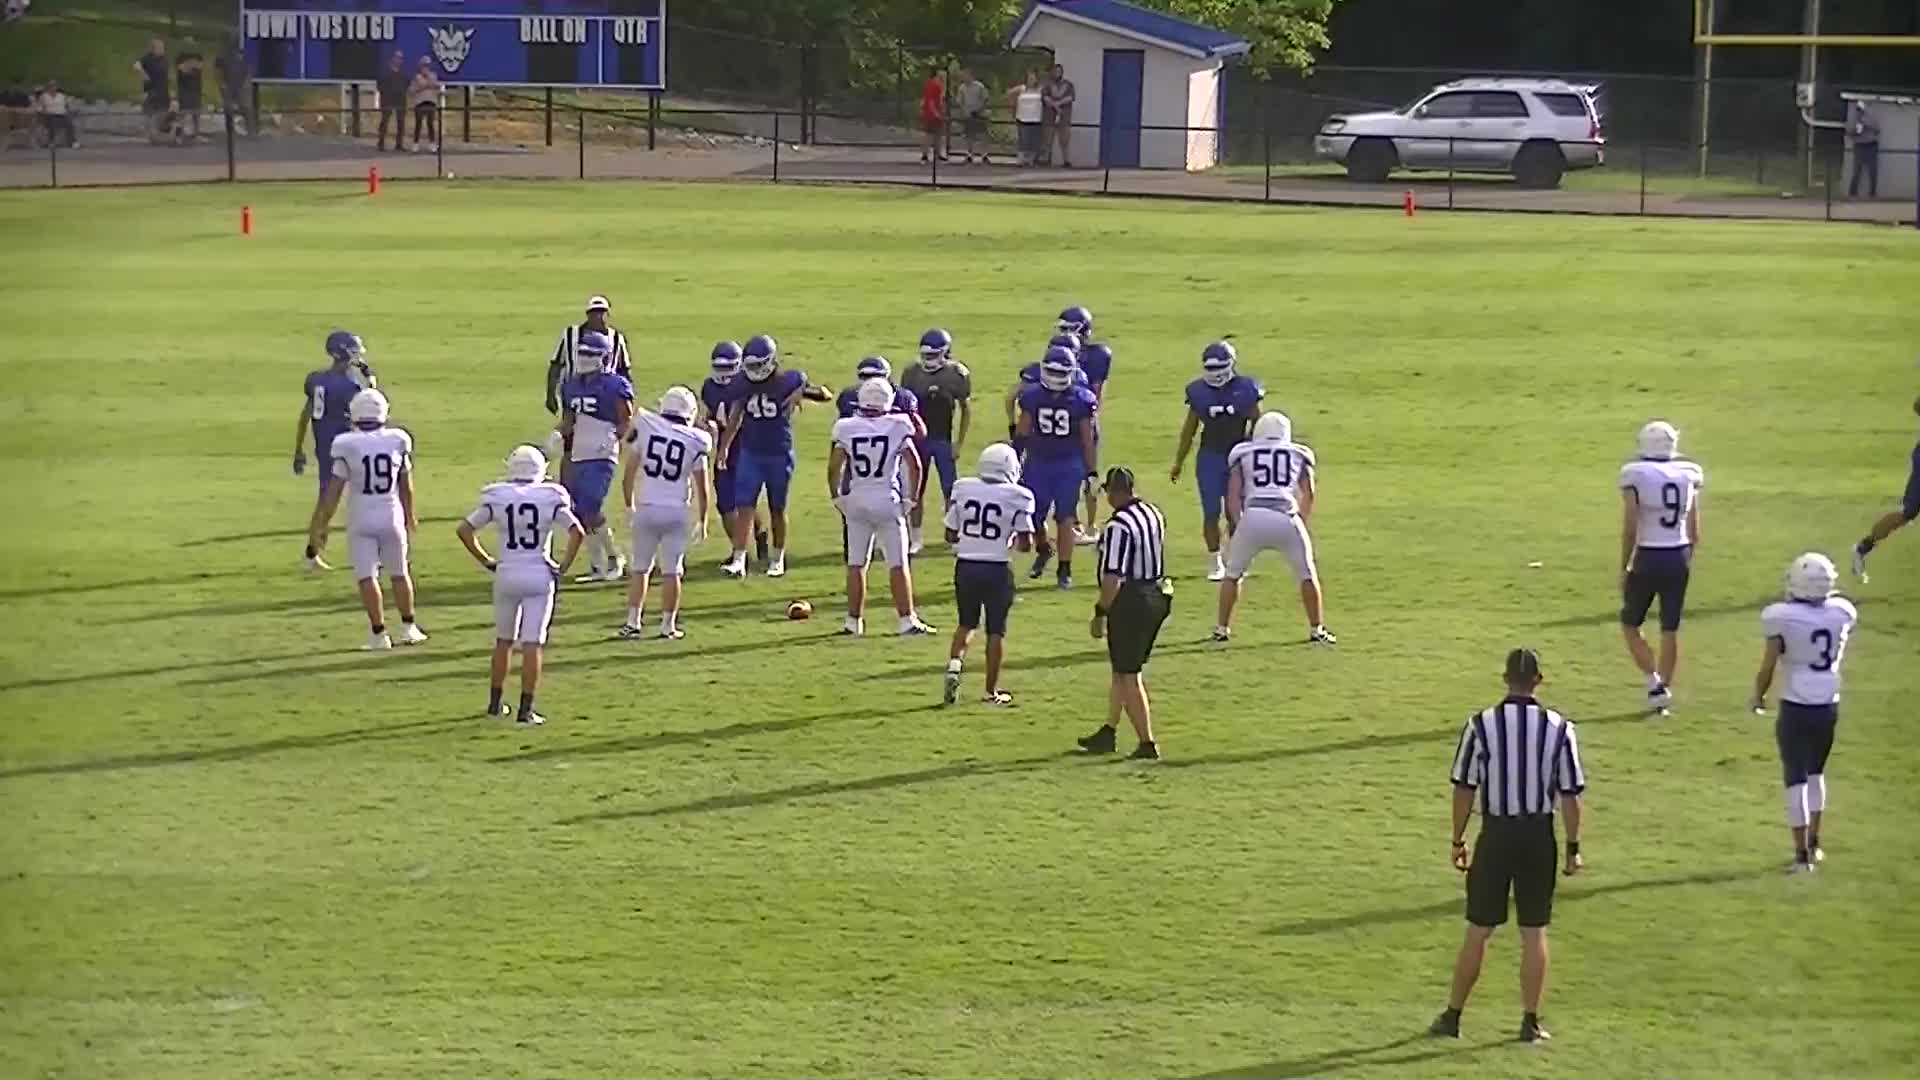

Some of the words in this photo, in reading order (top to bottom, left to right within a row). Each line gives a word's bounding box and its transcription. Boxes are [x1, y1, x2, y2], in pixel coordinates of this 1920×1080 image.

[615, 19, 647, 43] QTR
[1038, 408, 1070, 435] 53
[361, 453, 393, 495] 19
[644, 434, 686, 482] 59
[852, 435, 889, 478] 57
[1253, 449, 1291, 487] 50
[963, 500, 1002, 540] 26
[1660, 483, 1680, 527] 9
[505, 503, 539, 550] 13
[1809, 629, 1831, 672] 3
